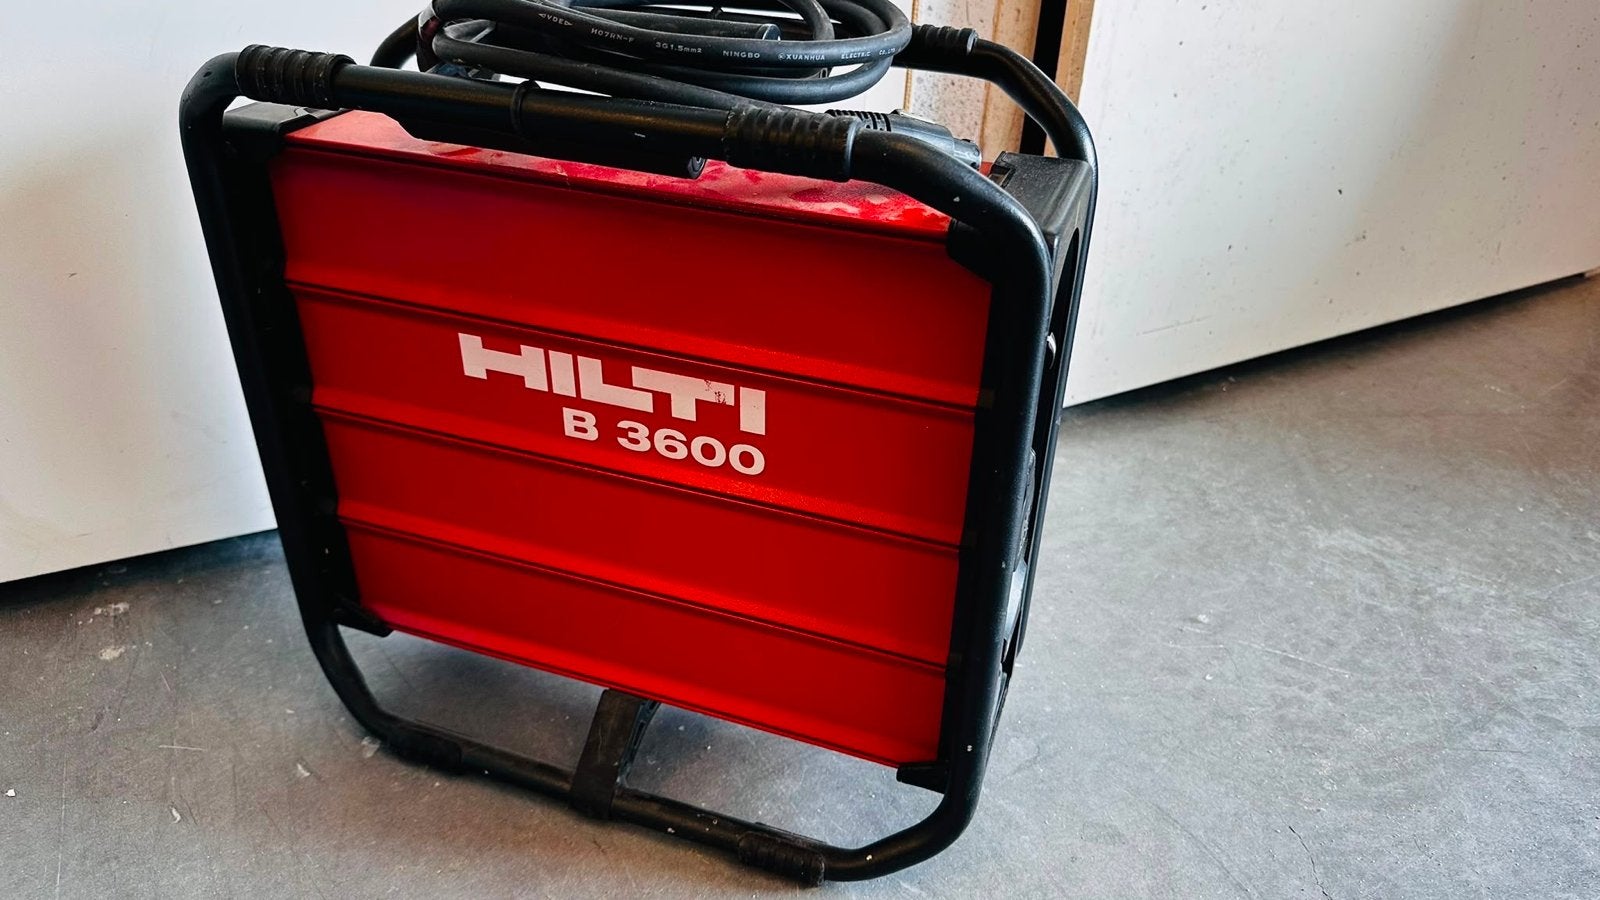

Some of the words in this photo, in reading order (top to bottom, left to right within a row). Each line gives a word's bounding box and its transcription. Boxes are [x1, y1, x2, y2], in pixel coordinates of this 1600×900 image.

[546, 14, 564, 25] VDE
[722, 50, 761, 59] NINGBO
[786, 53, 826, 61] XUANHUA
[458, 332, 766, 435] HILTI
[562, 406, 599, 441] B
[616, 420, 766, 476] 3600
